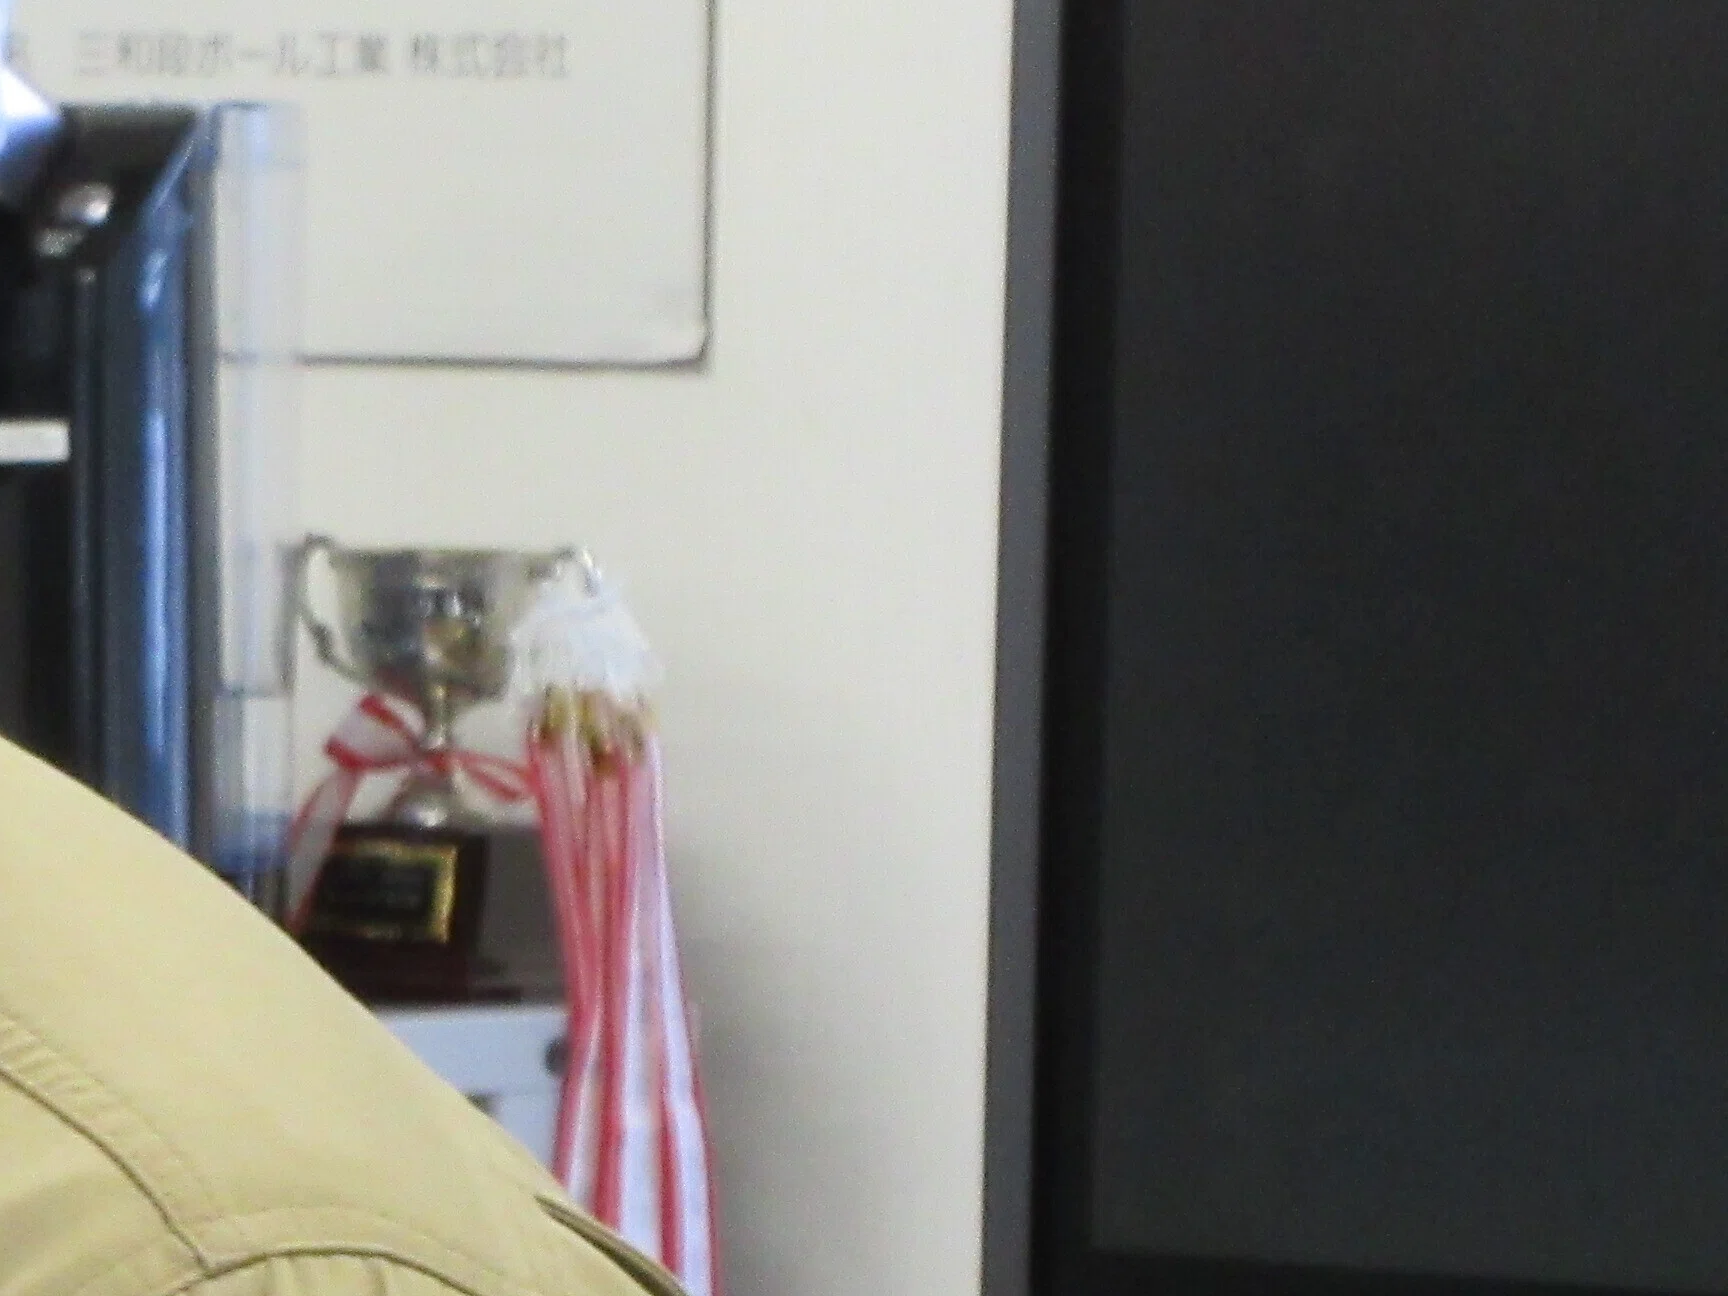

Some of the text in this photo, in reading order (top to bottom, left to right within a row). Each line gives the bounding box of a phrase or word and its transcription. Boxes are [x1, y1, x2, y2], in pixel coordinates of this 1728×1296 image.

[75, 32, 390, 81] 三和段ボール工業
[407, 32, 570, 80] 株式会社
